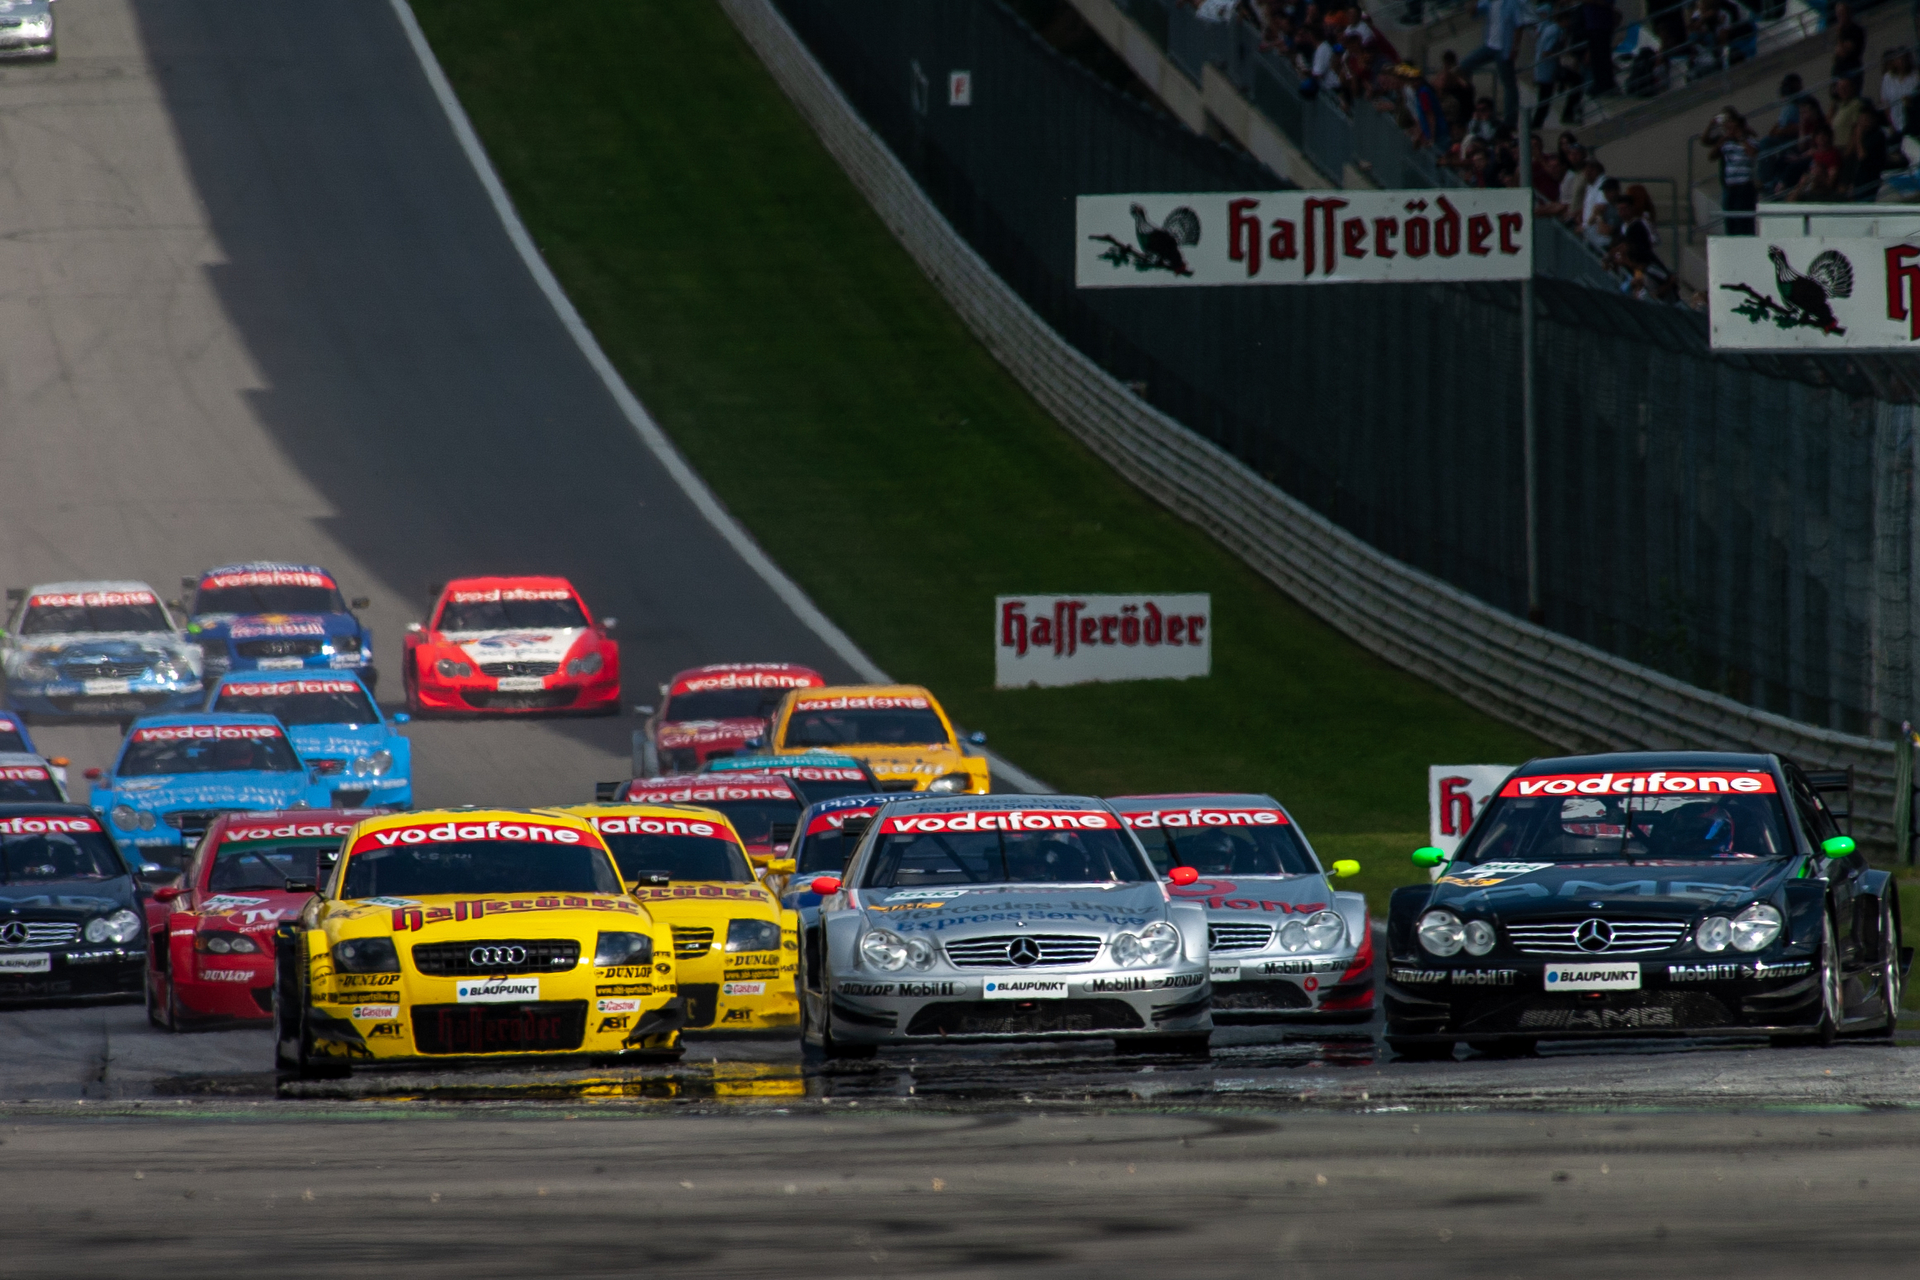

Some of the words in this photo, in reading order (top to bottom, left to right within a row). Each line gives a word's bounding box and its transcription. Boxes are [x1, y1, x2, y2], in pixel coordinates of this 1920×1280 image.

[213, 572, 323, 588] vodafone
[38, 592, 155, 607] vodafone
[453, 588, 569, 602] vodafone
[228, 681, 355, 696] vodafone
[686, 673, 811, 691] vodafone
[796, 696, 929, 711] vodafone
[141, 726, 276, 741] vodafone
[763, 767, 863, 781] afone
[1518, 772, 1762, 796] vodafone
[628, 786, 793, 804] vodafone
[918, 803, 1000, 814] Express
[1003, 802, 1082, 811] Service
[893, 812, 1107, 832] vodafone
[375, 821, 581, 846] vodafone
[242, 908, 286, 925] TV
[896, 911, 1021, 932] Express
[1027, 911, 1146, 926] Service
[734, 953, 780, 966] DUNLOP
[604, 967, 653, 978] DUNLOP
[1264, 961, 1299, 975] Mobil
[1668, 964, 1717, 981] Mobil
[203, 970, 255, 982] DUNLOP
[342, 975, 401, 986] DUNLOP
[1092, 978, 1132, 992] Mobil
[1162, 974, 1204, 987] DUNLOP
[1396, 969, 1447, 983] DUNLOP
[1451, 969, 1497, 985] Mobil
[1559, 970, 1639, 982] BLAUPUNKT
[470, 985, 537, 996] BLAUPUNKT
[842, 983, 894, 996] DUNLOP
[899, 982, 939, 996] Mobil
[997, 980, 1066, 992] BLAUPUNKT
[360, 1006, 393, 1017] Castrol
[605, 1001, 635, 1011] Castrol
[720, 1008, 754, 1022] ABT
[366, 1022, 404, 1038] ABT
[596, 1015, 631, 1033] ABT
